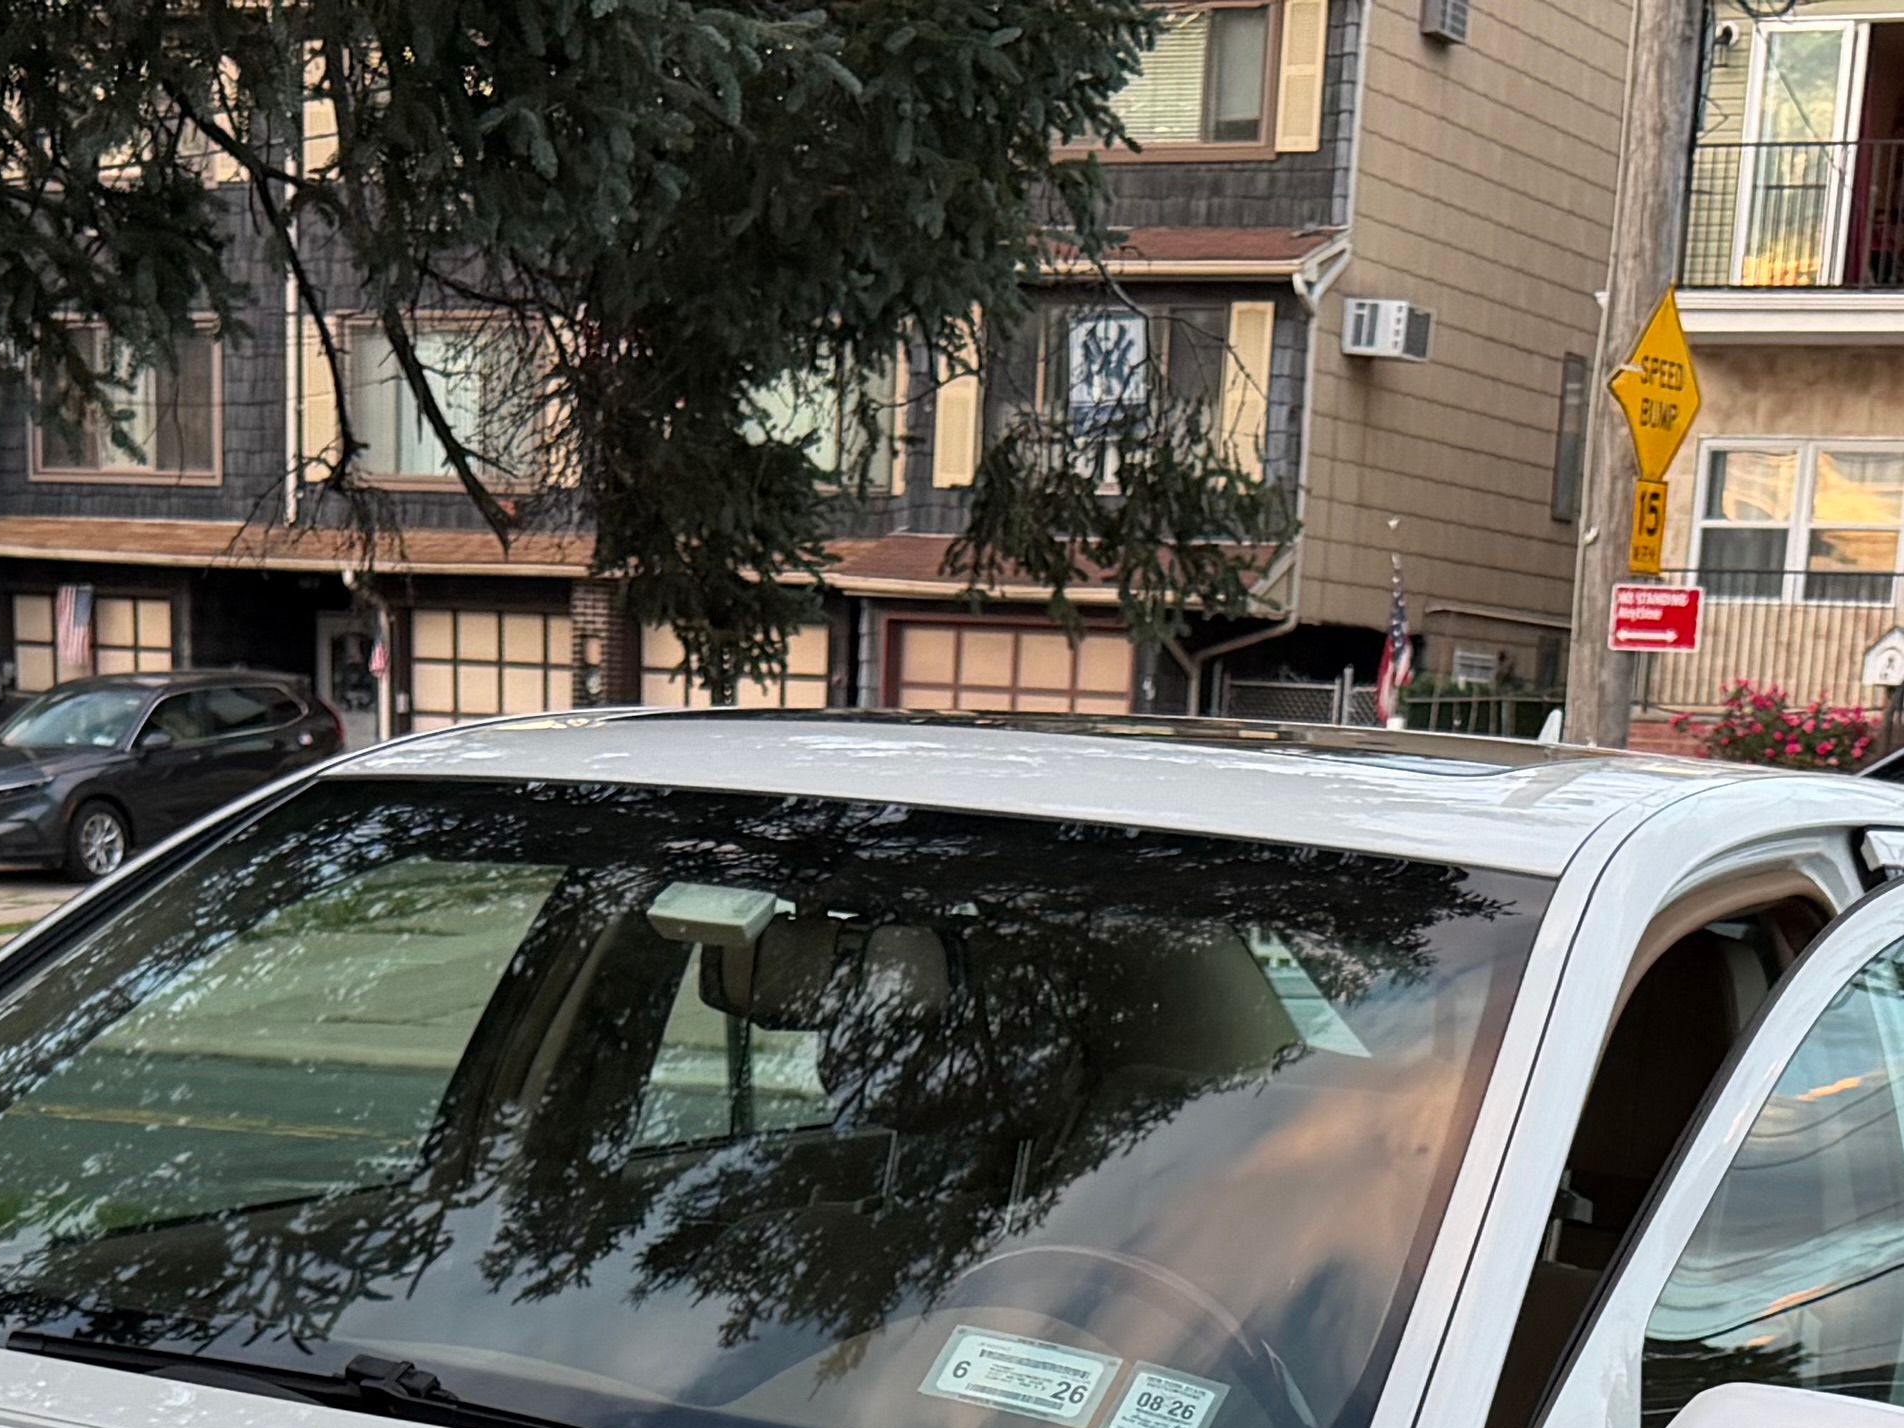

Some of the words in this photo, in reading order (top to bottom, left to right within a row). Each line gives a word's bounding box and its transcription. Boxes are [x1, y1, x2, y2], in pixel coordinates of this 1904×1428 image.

[1641, 355, 1684, 391] SPEED
[1640, 398, 1679, 431] BUMP
[1638, 491, 1660, 536] 15
[953, 1361, 971, 1378] 6
[1050, 1381, 1088, 1404] 26
[1137, 1391, 1163, 1411] 08
[1167, 1400, 1196, 1420] 26
